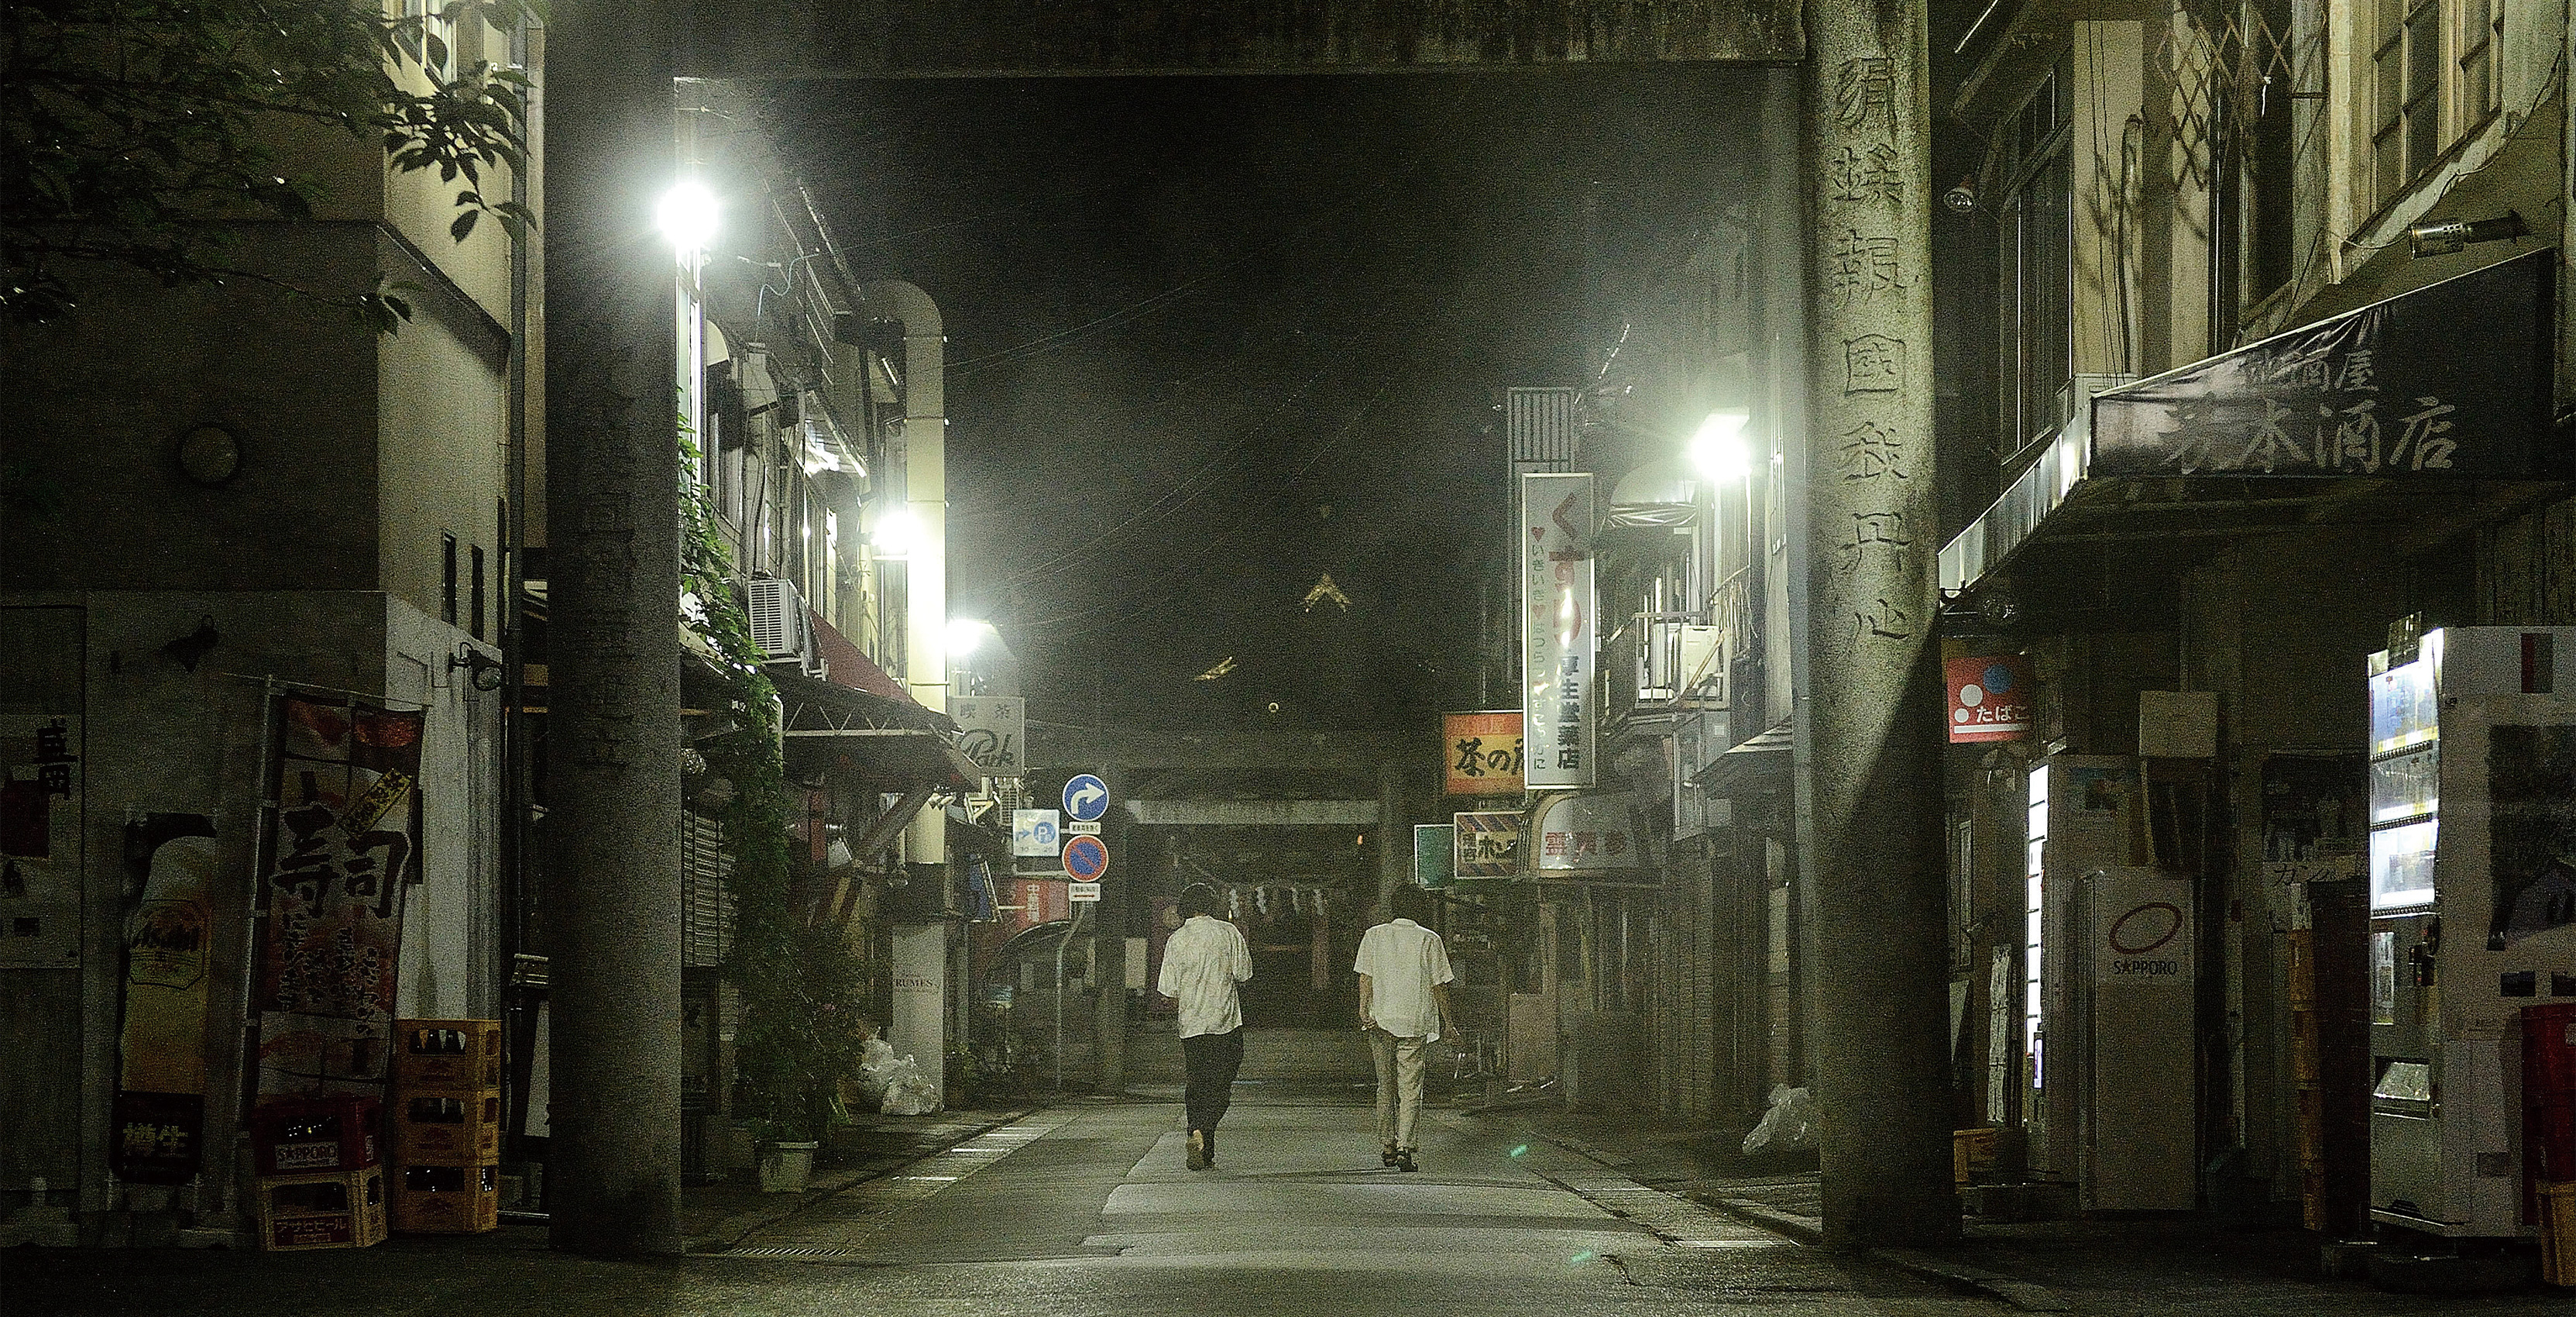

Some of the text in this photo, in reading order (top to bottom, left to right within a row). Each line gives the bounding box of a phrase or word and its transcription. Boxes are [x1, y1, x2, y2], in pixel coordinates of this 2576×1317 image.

[1549, 493, 1585, 648] くすり
[1976, 705, 2030, 723] たばこ
[272, 803, 407, 920] 寿司
[276, 1218, 347, 1235] アサヒビール
